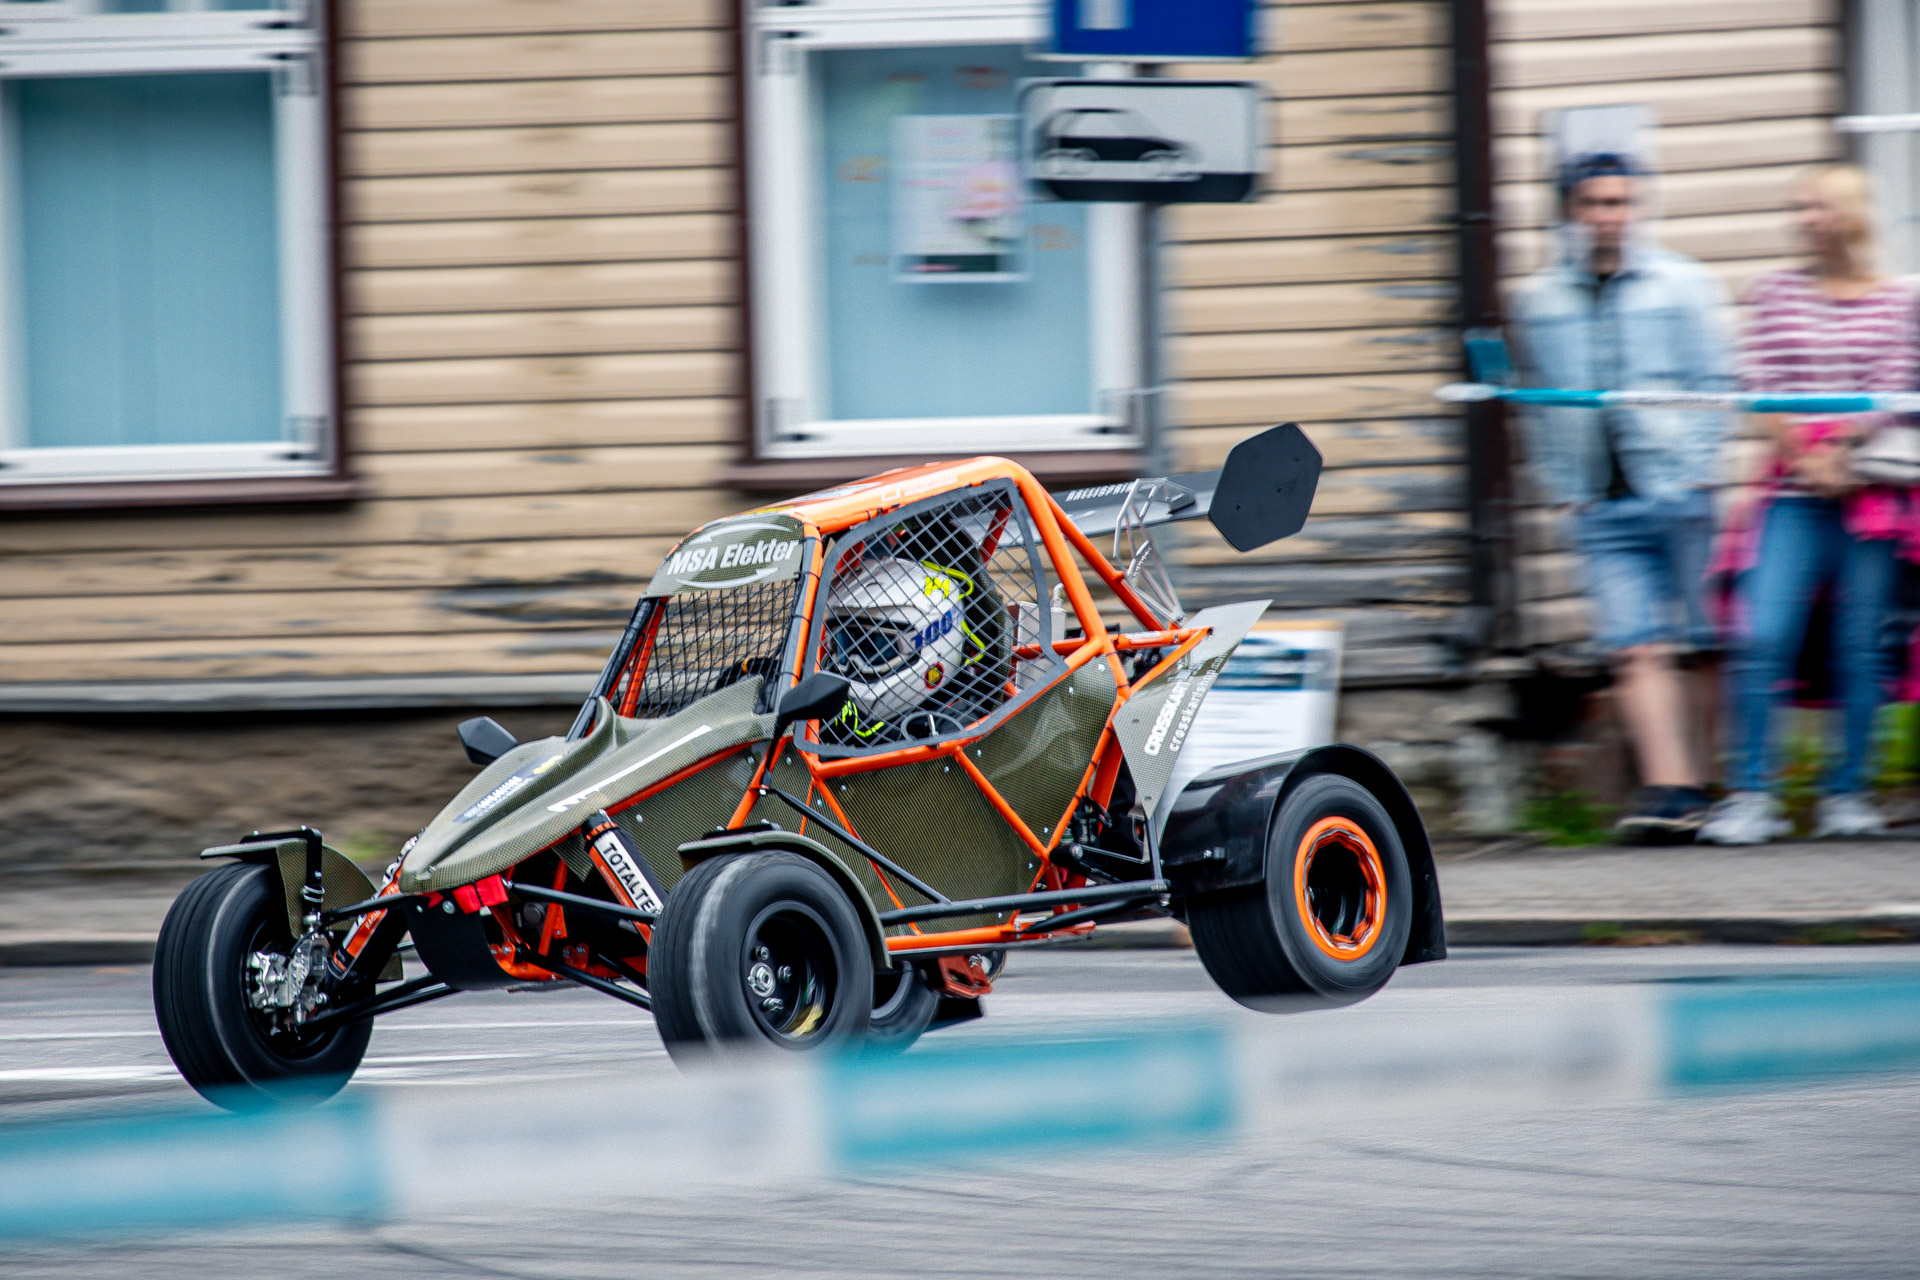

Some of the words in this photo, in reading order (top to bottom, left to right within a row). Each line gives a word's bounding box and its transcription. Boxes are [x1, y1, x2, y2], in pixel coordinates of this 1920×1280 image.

[667, 546, 718, 576] MSA
[720, 538, 799, 569] Elekter
[600, 841, 661, 914] TOTALTE
